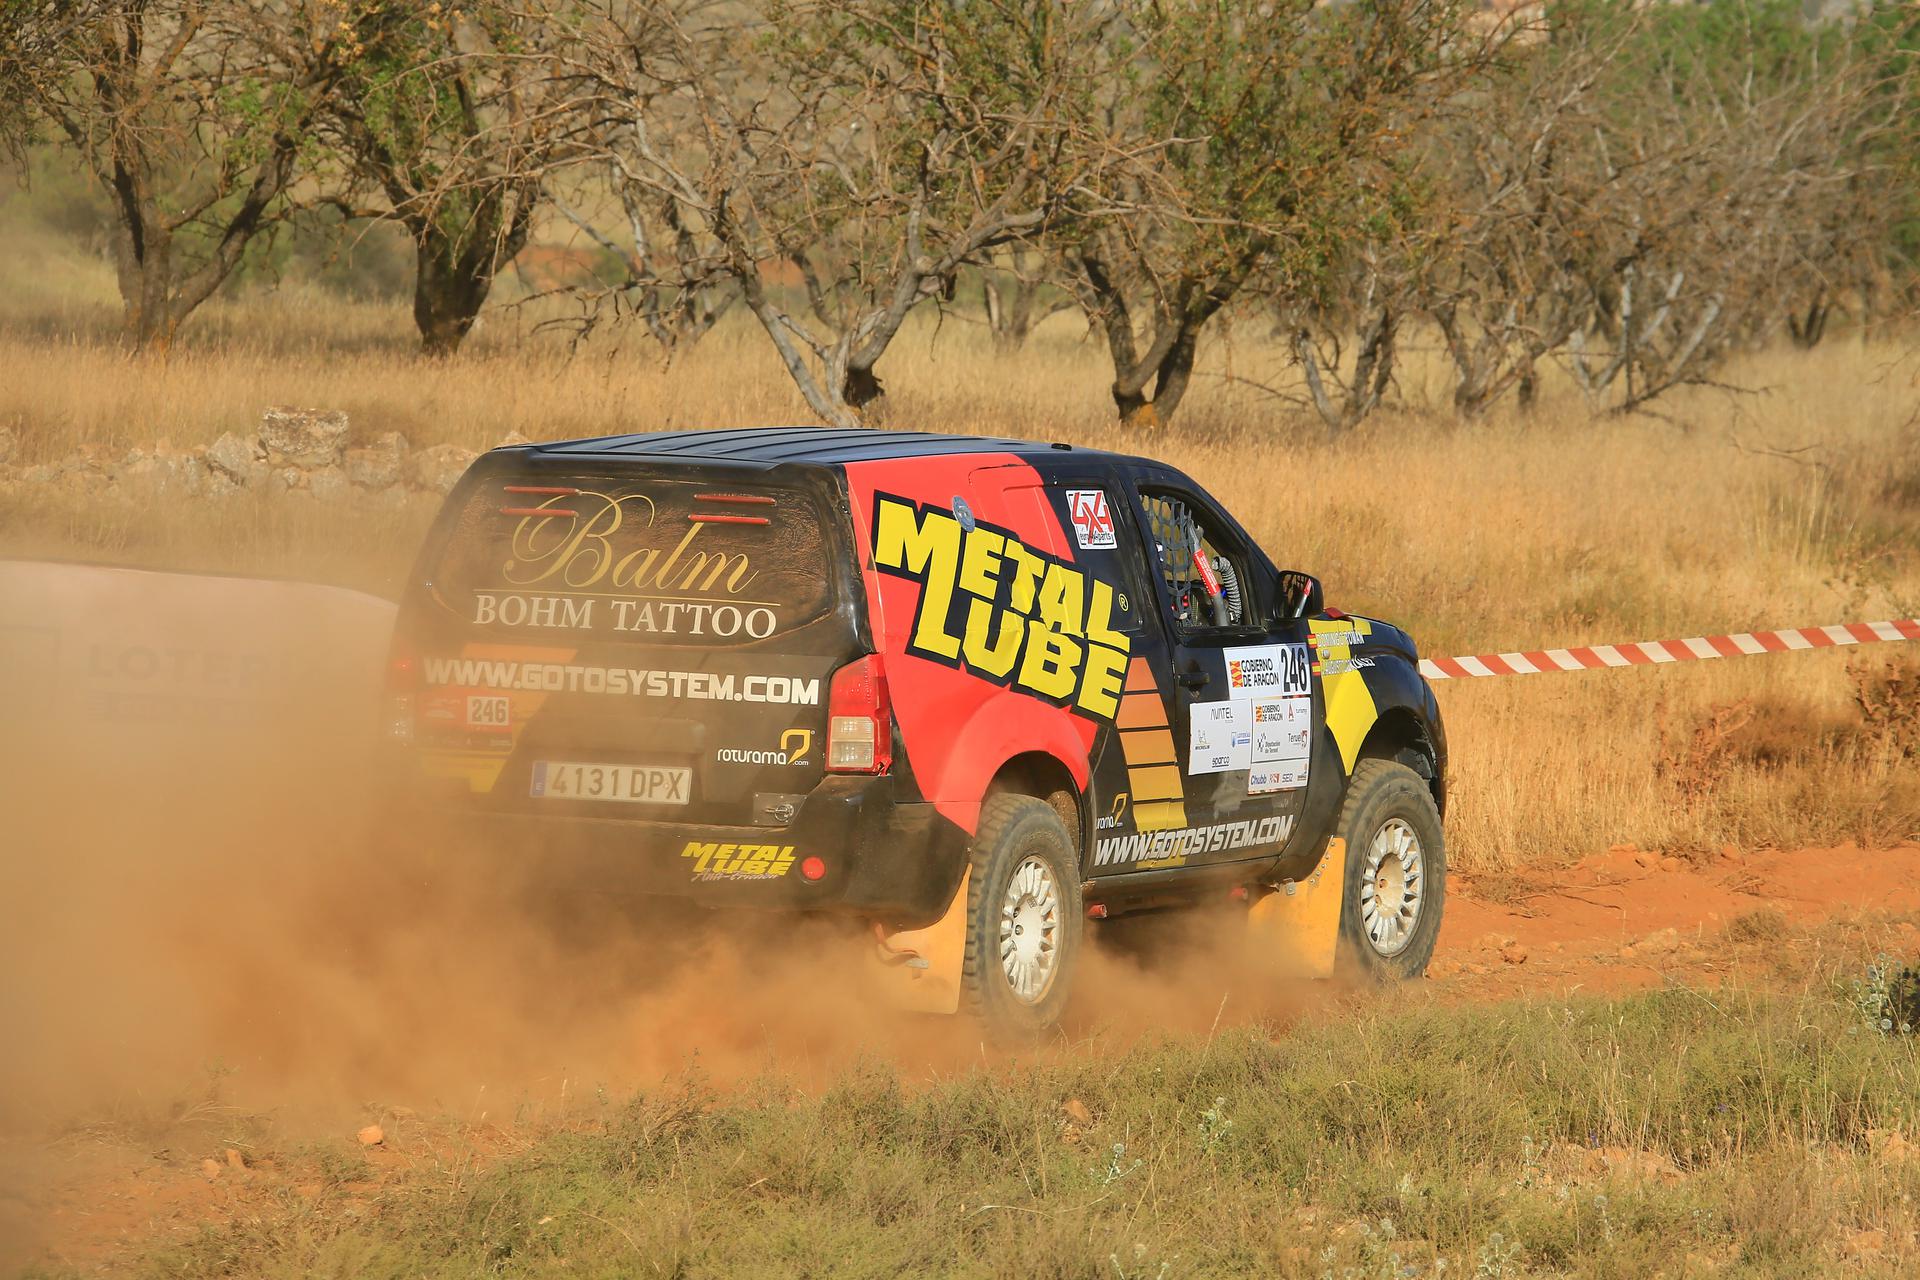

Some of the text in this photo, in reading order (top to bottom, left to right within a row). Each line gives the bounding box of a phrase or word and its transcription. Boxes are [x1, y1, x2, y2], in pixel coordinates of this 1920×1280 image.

[503, 491, 760, 594] Balm
[875, 499, 1131, 653] METAL
[473, 594, 777, 639] BOHM TATTOO
[913, 585, 1129, 720] LUBE
[1241, 658, 1274, 673] GOBIERNO
[1280, 647, 1308, 693] 246
[423, 657, 820, 706] WWW.GOTOSYSTEM.COM
[1242, 672, 1280, 688] DE ARAGON
[471, 698, 507, 724] 246
[1262, 704, 1281, 713] GOBIERNO
[1262, 713, 1268, 723] DE
[716, 748, 788, 766] roturama
[1211, 756, 1230, 766] sparco
[551, 766, 684, 800] 4131 DPX
[1250, 773, 1267, 785] Chubb
[681, 841, 797, 862] METAL
[1094, 814, 1294, 866] WWW.GOTOSYSTEM.COM
[693, 857, 793, 876] LUBE
